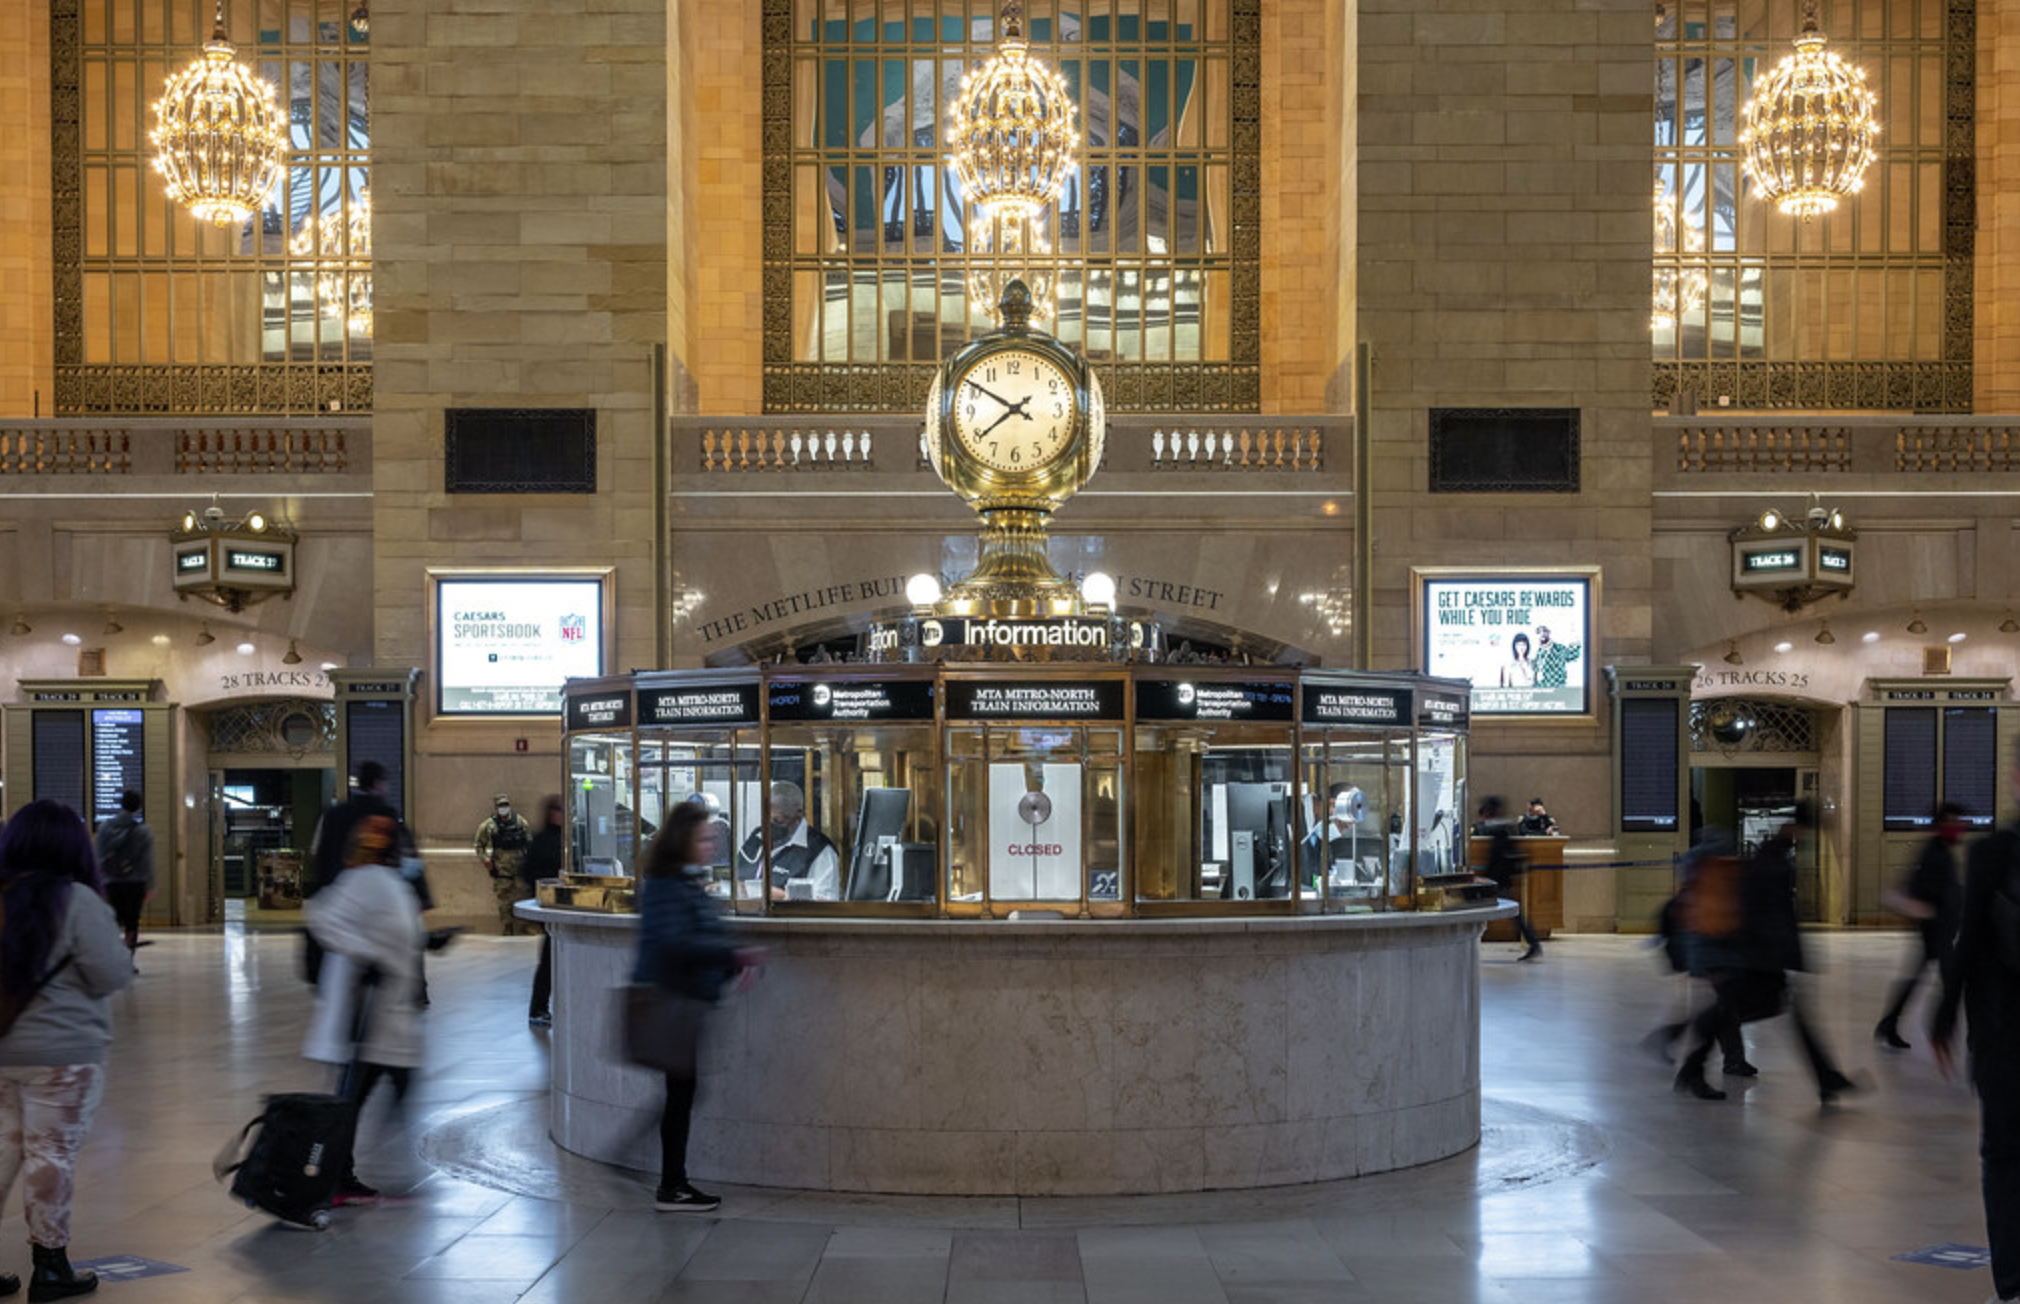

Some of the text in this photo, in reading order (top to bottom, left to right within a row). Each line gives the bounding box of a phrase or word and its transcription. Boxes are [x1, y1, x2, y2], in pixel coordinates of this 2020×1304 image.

[1007, 361, 1020, 375] 12
[1034, 367, 1040, 381] 1
[987, 368, 996, 383] 11
[1049, 380, 1058, 395] 2
[966, 405, 976, 423] 9
[1053, 402, 1063, 419] 3
[972, 428, 982, 444] 8
[1048, 427, 1058, 442] 4
[989, 442, 998, 457] 7
[1010, 446, 1020, 464] 6
[1031, 442, 1042, 459] 5
[1129, 577, 1224, 609] STREET
[1438, 591, 1575, 608] GET CAESARS REWARDS
[454, 612, 506, 621] CAESARS
[698, 612, 748, 642] THE
[752, 583, 854, 625] METLIFE
[1438, 609, 1531, 625] WHILE YOU RIDE
[454, 624, 541, 638] SPORTSBOOK
[562, 627, 583, 640] NFL
[964, 619, 1105, 645] Information
[221, 675, 240, 689] 28
[243, 672, 311, 687] TRACKS
[1717, 671, 1786, 686] TRACKS
[1790, 674, 1808, 688] 25
[833, 690, 882, 700] Metropolitan
[976, 689, 1094, 699] MTA METRO-NORTH
[1197, 690, 1244, 699] Metropolitan
[1320, 694, 1338, 704] MTA
[658, 696, 676, 707] MTA
[833, 699, 890, 709] Transportation
[971, 701, 1100, 711] TRAIN INFORMATION
[1197, 699, 1252, 708] Transportation
[655, 704, 743, 718] TRAIN INFORMATION
[833, 708, 869, 718] Authority
[1197, 708, 1232, 718] Authority
[1316, 705, 1397, 718] TRAIN INFORMATION
[1008, 844, 1062, 856] CLOSED
